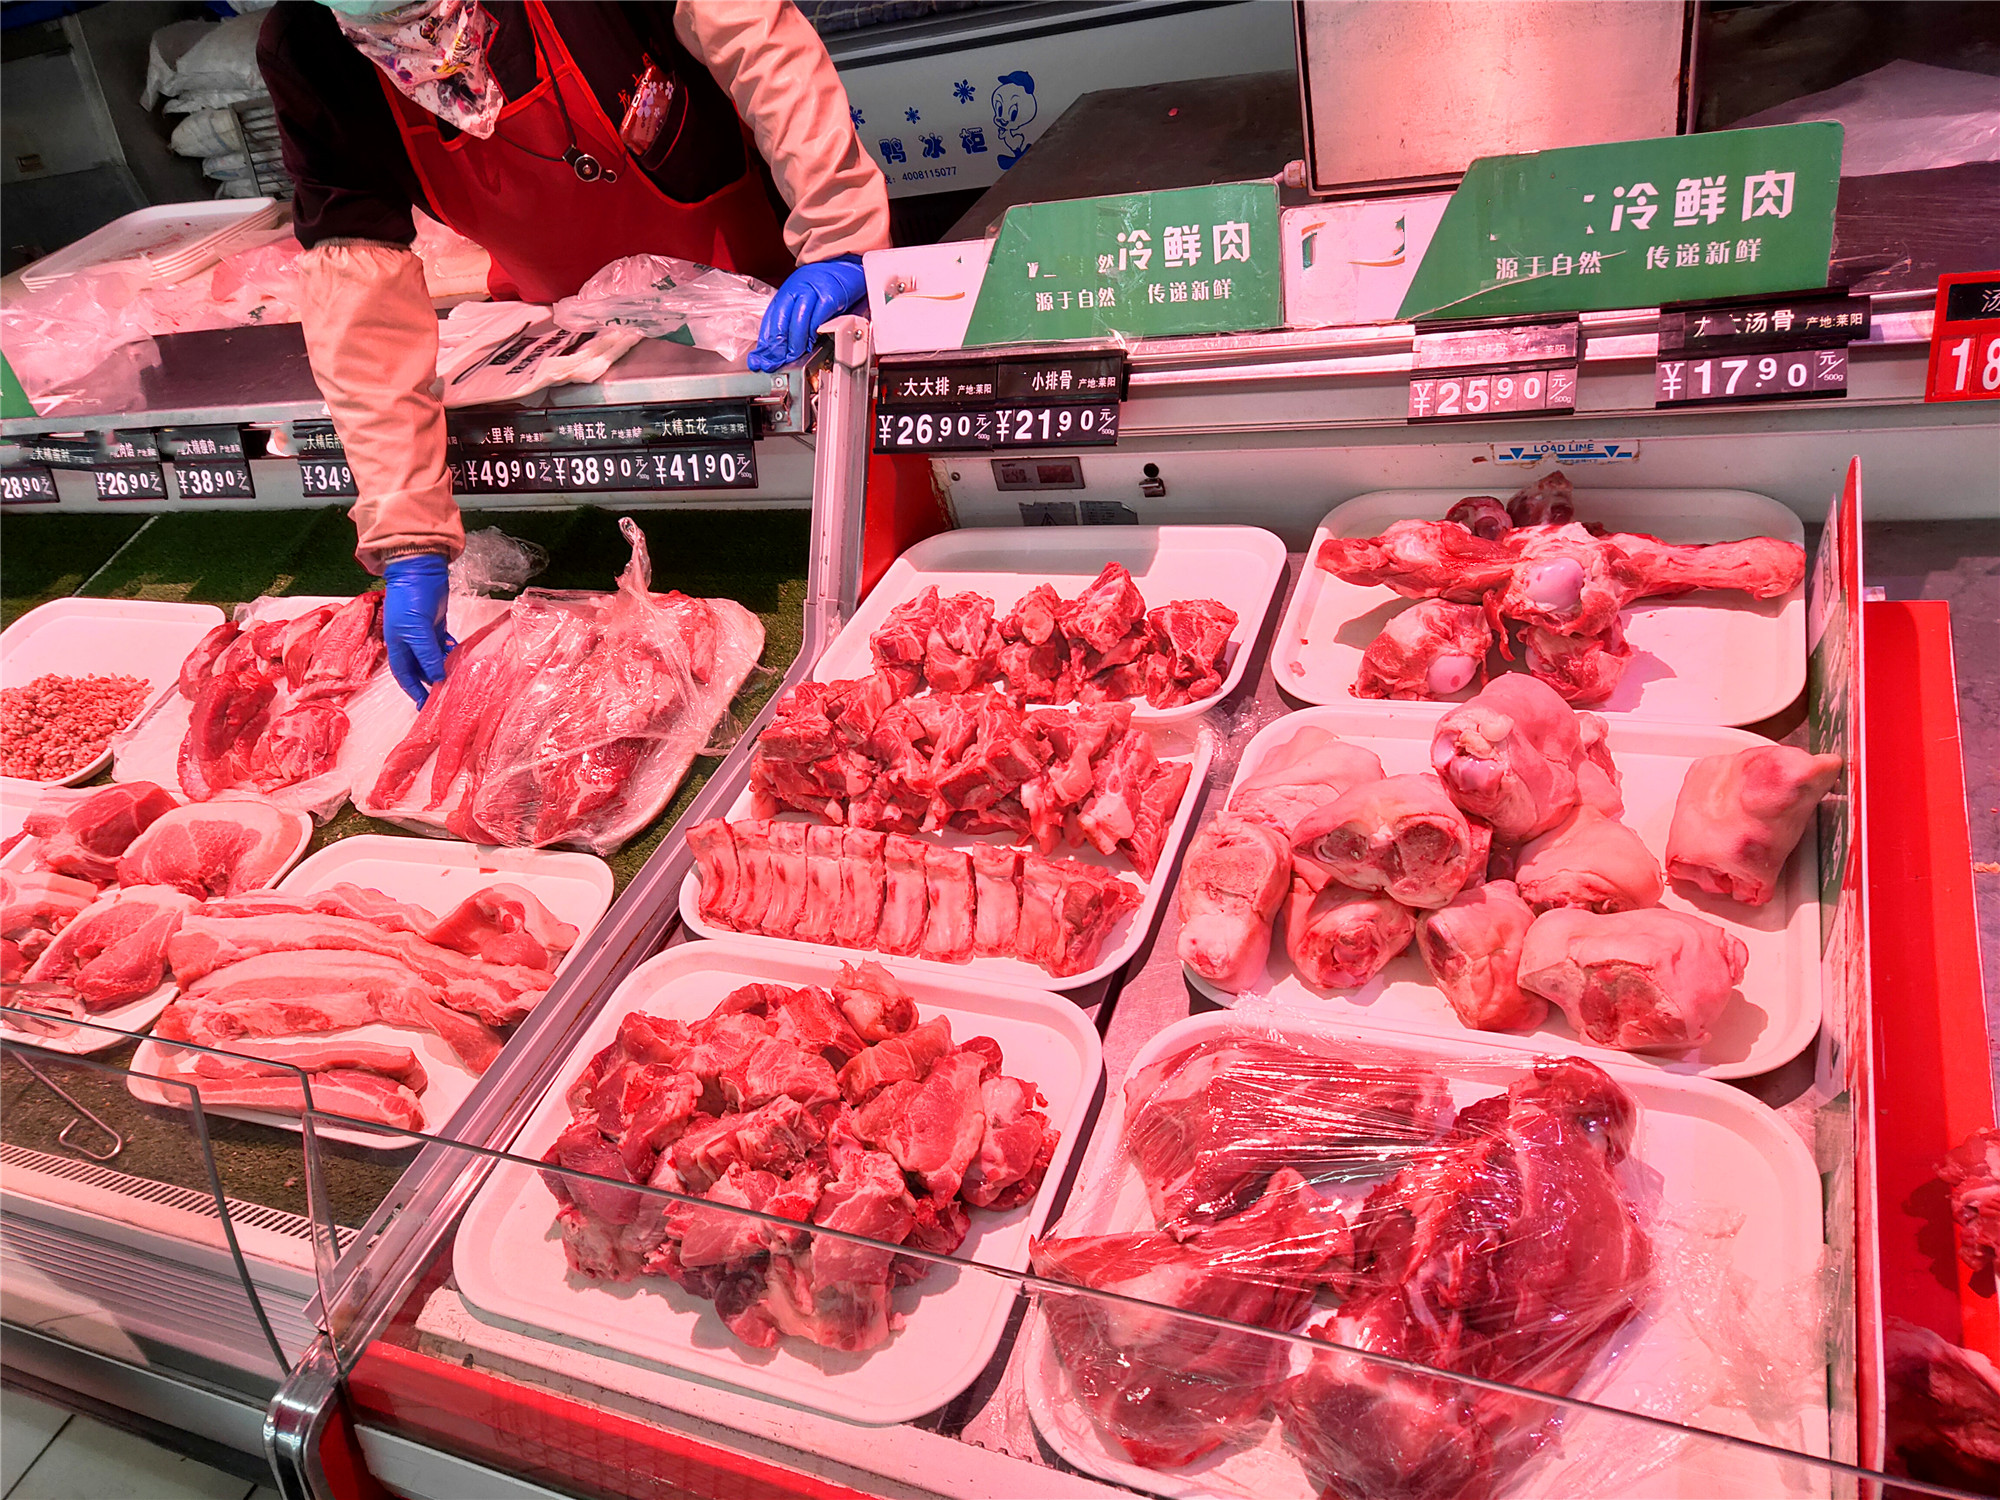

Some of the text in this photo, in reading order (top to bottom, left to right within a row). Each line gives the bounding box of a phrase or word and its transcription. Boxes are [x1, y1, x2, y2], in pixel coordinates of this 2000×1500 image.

[902, 166, 957, 181] 4008115077
[1610, 170, 1796, 232] 冷鲜肉
[1116, 220, 1251, 271] 冷鲜肉
[1495, 238, 1763, 280] 源于自然 传递新鲜
[1035, 278, 1233, 312] 源于自然 传递新鲜
[1805, 313, 1864, 330] 产地:莱阳
[1032, 370, 1073, 391] 小排骨
[1661, 357, 1807, 399] ¥17.90
[1413, 377, 1541, 417] ¥25.90
[662, 416, 708, 437] 大精五花
[878, 414, 970, 446] ¥26.90
[996, 409, 1094, 442] ¥21.90
[1533, 443, 1595, 453] LOAD LINE
[95, 472, 149, 495] ¥26.90
[175, 470, 235, 495] ¥38.90
[465, 460, 536, 488] ¥49.90
[552, 457, 632, 486] ¥38.90
[652, 453, 736, 485] ¥41.90
